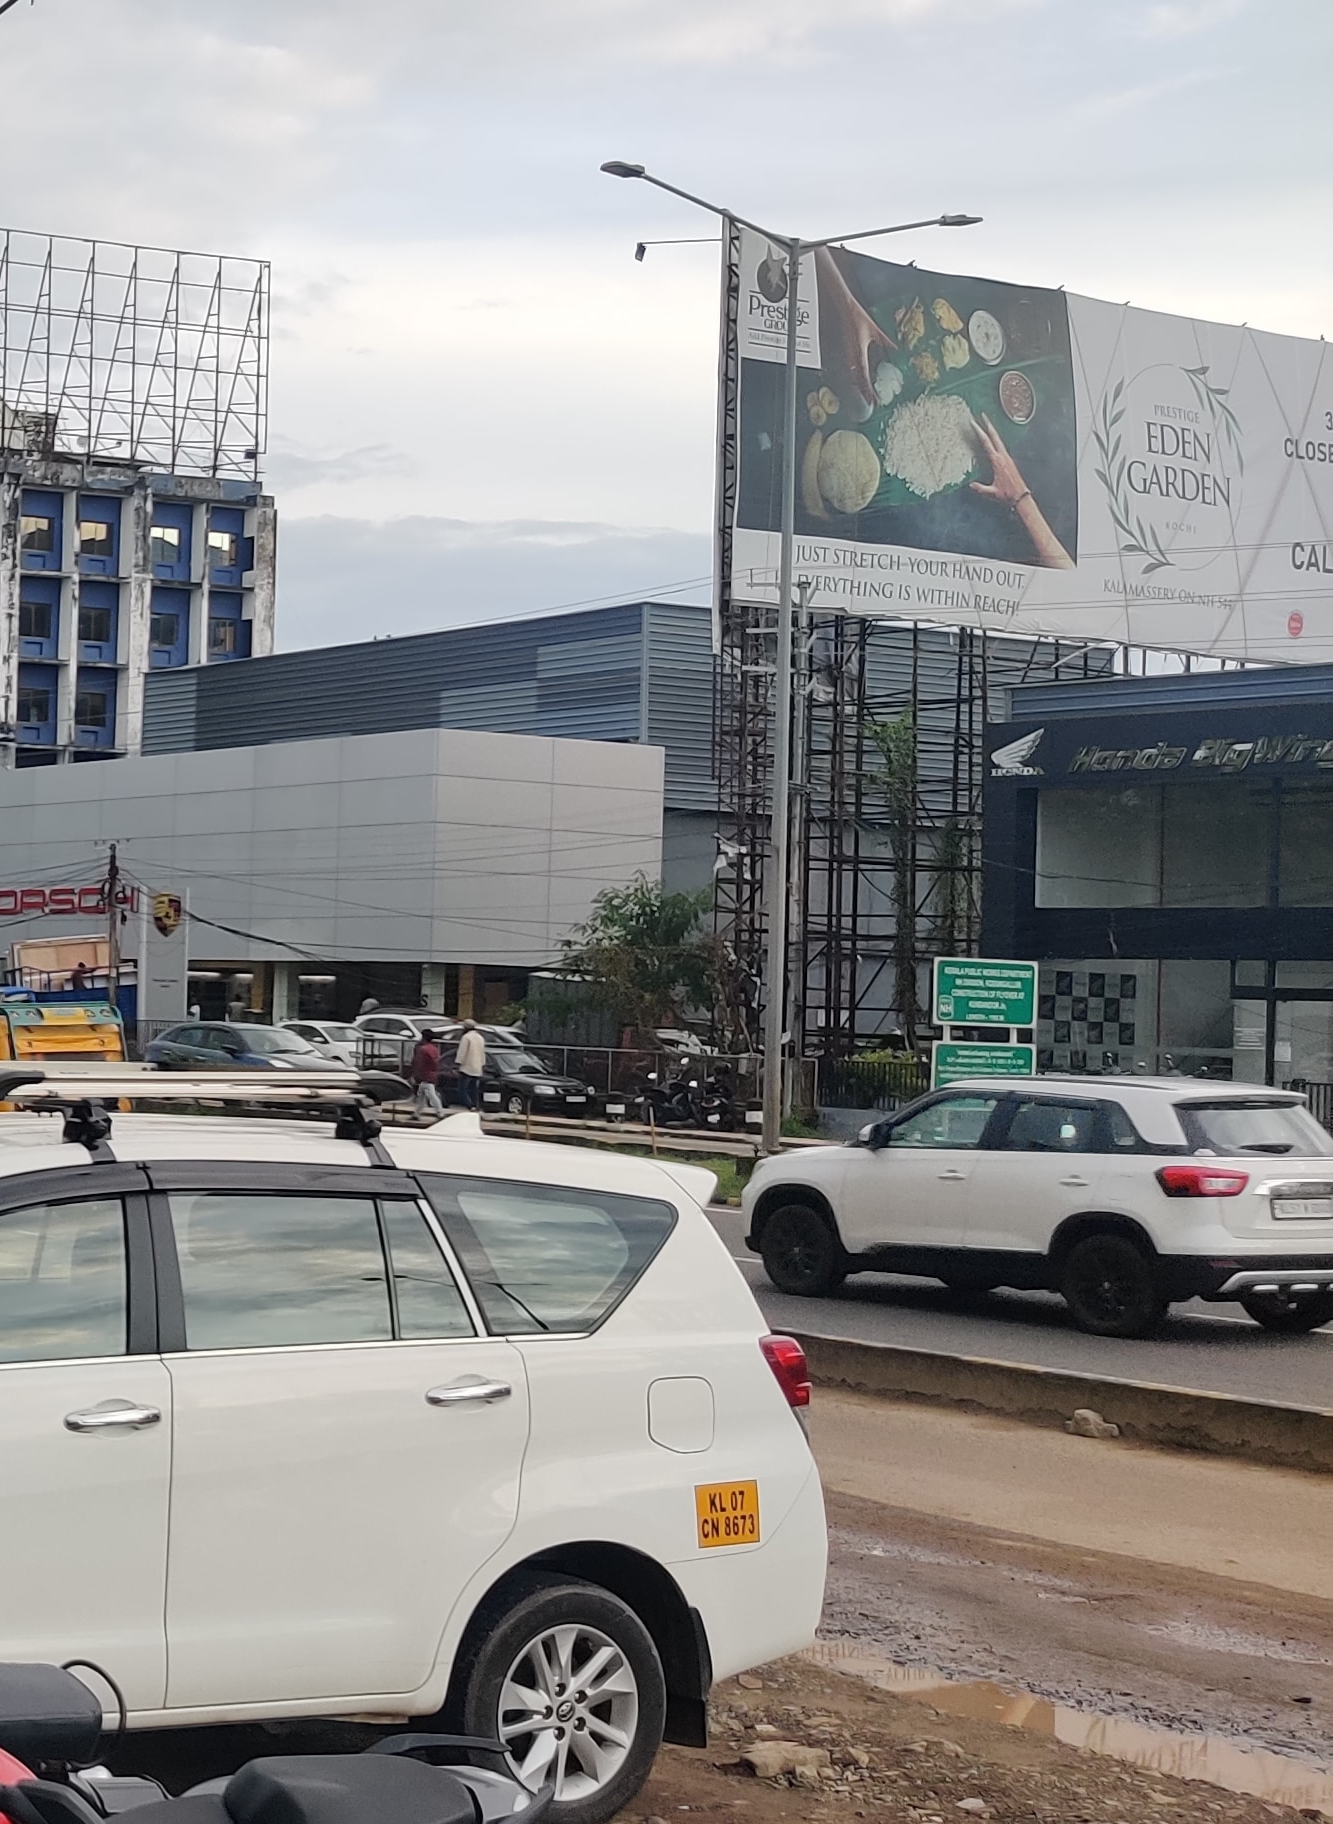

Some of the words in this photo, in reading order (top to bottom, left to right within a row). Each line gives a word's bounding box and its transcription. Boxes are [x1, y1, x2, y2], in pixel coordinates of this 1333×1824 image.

[1154, 404, 1200, 425] PRESTIGE
[1144, 420, 1212, 465] EDEN
[1126, 460, 1231, 508] GARDEN
[1165, 521, 1197, 535] KOCHI
[796, 544, 830, 564] JUST
[833, 548, 901, 571] STRETCH
[907, 556, 949, 577] YOUR
[952, 562, 994, 584] HAND
[996, 570, 1025, 590] OUT.
[898, 583, 911, 602] IS
[915, 586, 971, 609] WITHIN
[973, 593, 1020, 617] REACH!
[1103, 578, 1176, 600] KALAMASSERY
[1178, 589, 1195, 603] ON
[1199, 594, 1214, 607] NH
[990, 766, 1045, 777] HONDA
[1068, 742, 1186, 775] Honda
[708, 1492, 727, 1514] KL
[730, 1490, 745, 1512] 07
[701, 1517, 720, 1539] CN
[724, 1513, 755, 1537] 8673
